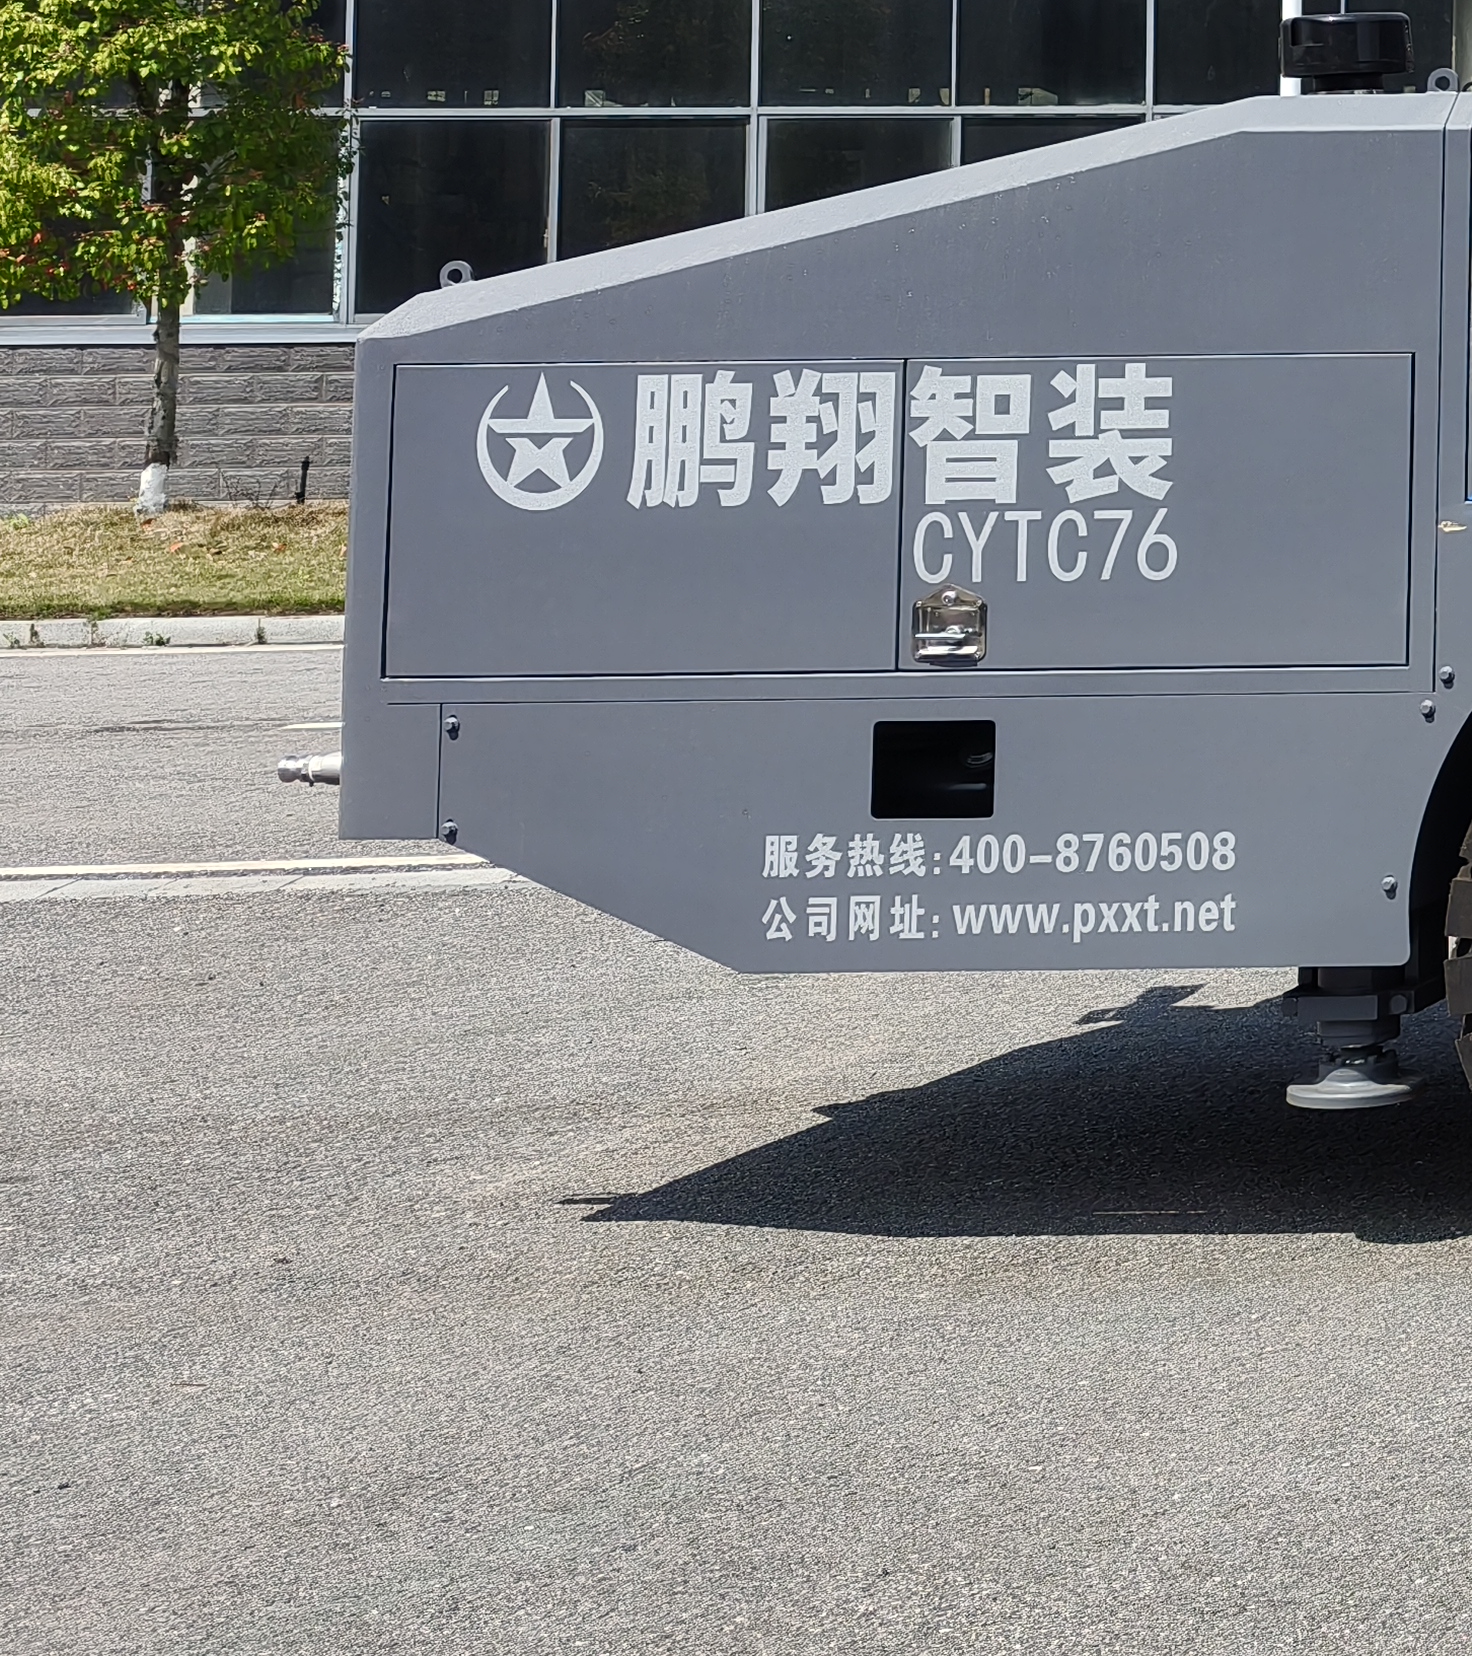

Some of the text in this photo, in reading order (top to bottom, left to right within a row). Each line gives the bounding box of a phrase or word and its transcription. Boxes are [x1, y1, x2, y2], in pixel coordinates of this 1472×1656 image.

[626, 363, 1174, 510] 鹏翔智装
[913, 507, 1178, 584] CYTC76
